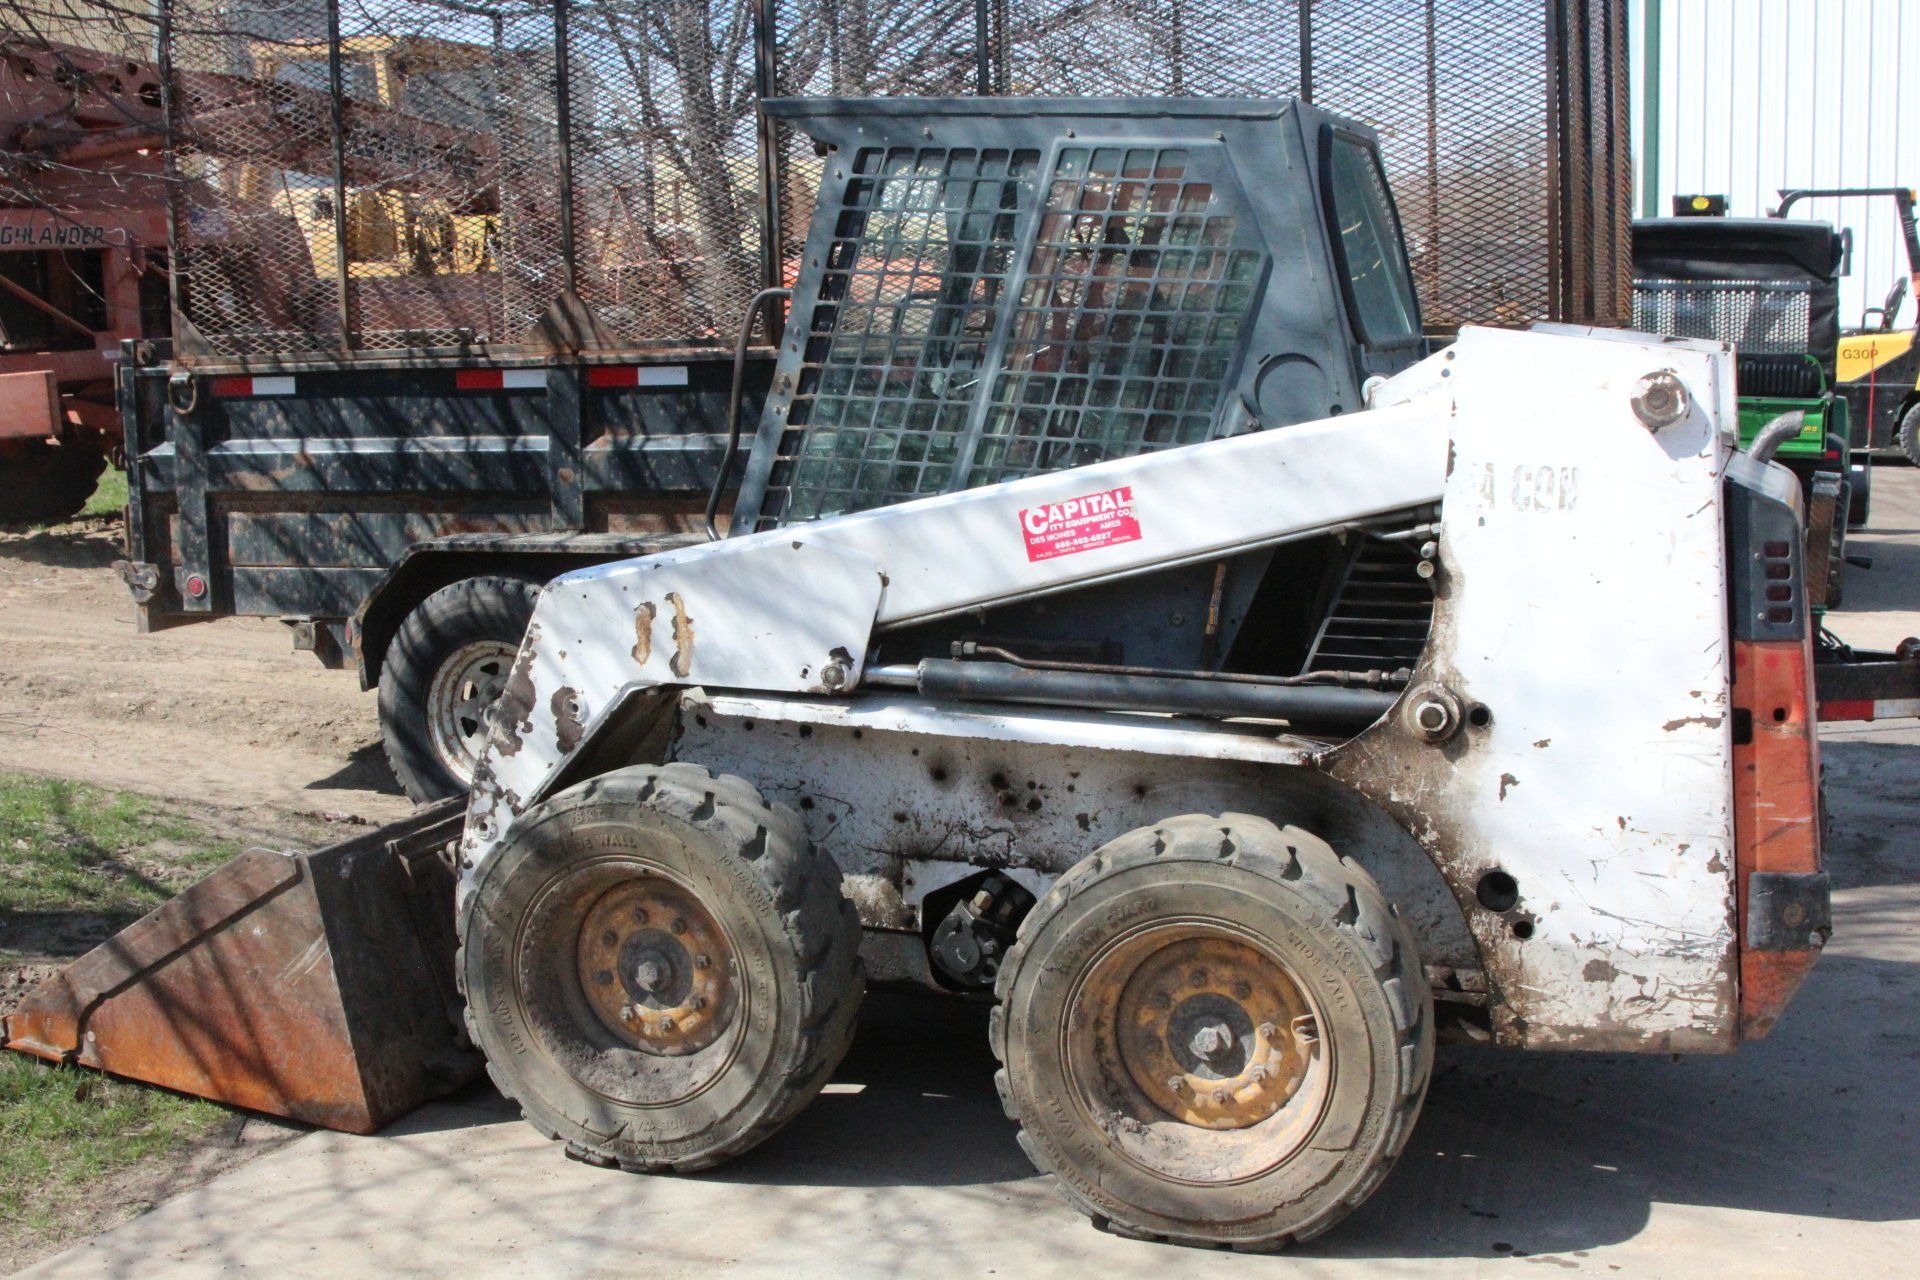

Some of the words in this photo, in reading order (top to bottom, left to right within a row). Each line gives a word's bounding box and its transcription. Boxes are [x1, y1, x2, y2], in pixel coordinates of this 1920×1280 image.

[1843, 349, 1879, 360] G30P
[1024, 490, 1129, 535] CAPITAL
[1065, 510, 1115, 529] EQUIPMENT
[1029, 536, 1046, 545] DES
[1046, 529, 1077, 541] MOINES
[1099, 519, 1122, 530] AMES
